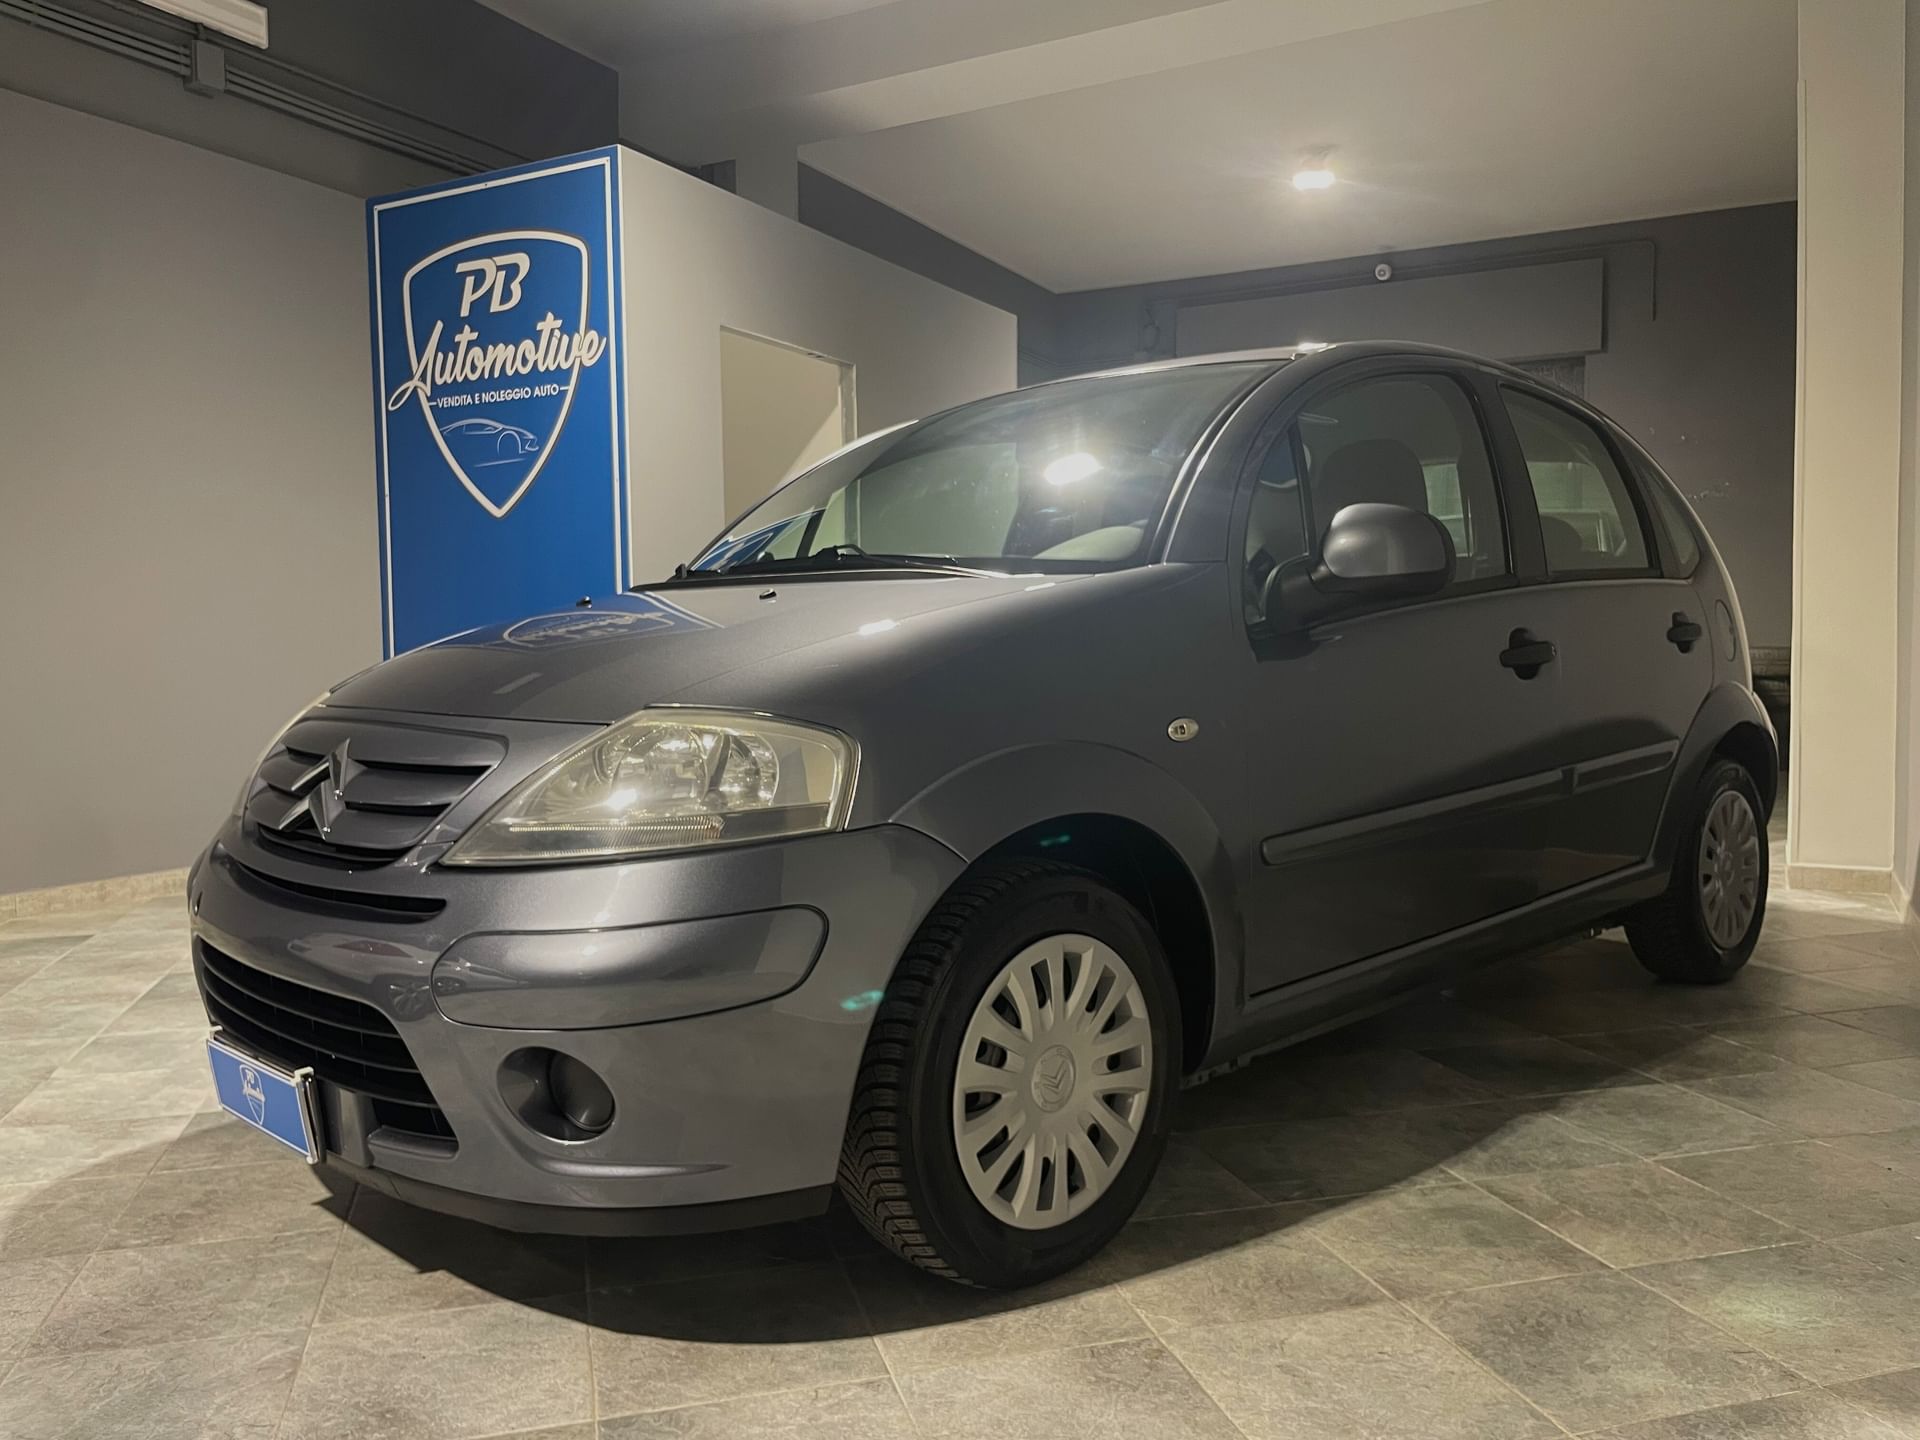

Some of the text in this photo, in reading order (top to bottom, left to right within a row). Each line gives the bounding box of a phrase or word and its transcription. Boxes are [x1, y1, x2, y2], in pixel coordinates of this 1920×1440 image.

[455, 252, 530, 317] PB
[388, 311, 607, 411] Automotive
[437, 383, 559, 408] VENDITA E NOLEGGIO AUTO
